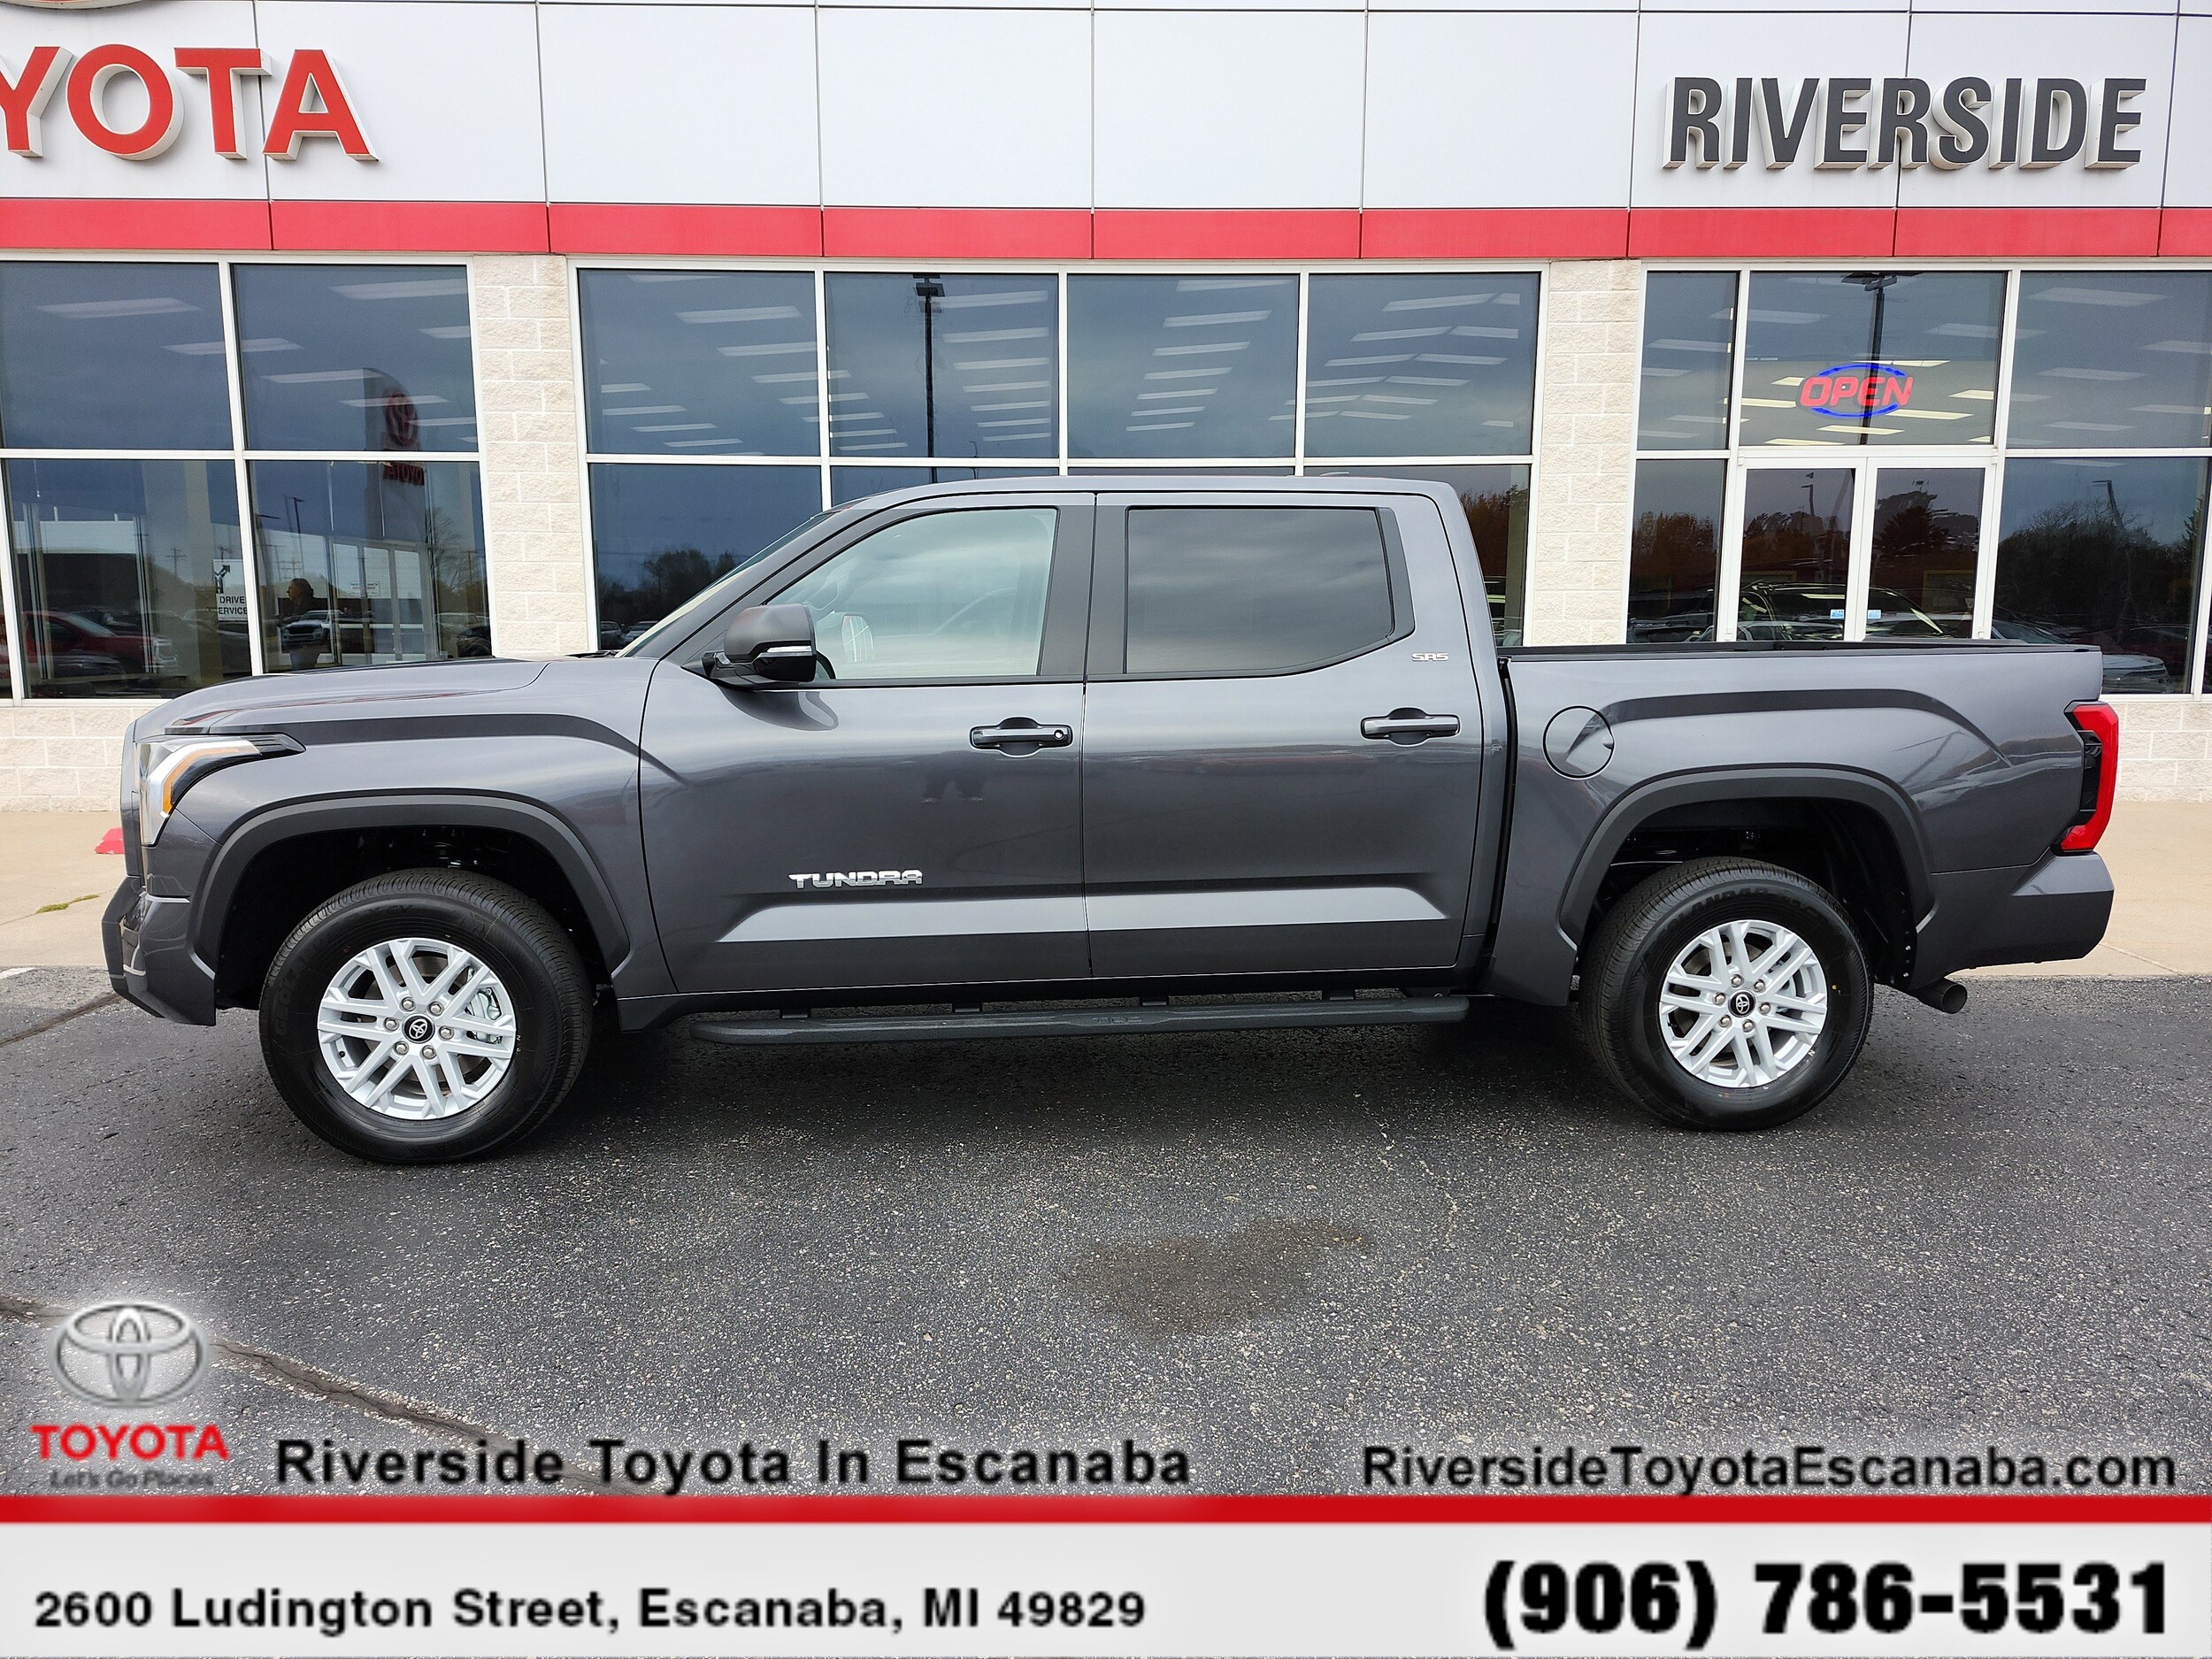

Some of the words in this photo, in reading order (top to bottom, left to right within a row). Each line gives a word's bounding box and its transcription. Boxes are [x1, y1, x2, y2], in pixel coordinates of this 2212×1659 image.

[0, 43, 379, 162] YOTA
[1663, 76, 2147, 170] RIVERSIDE
[1800, 376, 1914, 407] OPEN
[1411, 651, 1449, 662] SR5
[787, 869, 923, 889] TUNDRA
